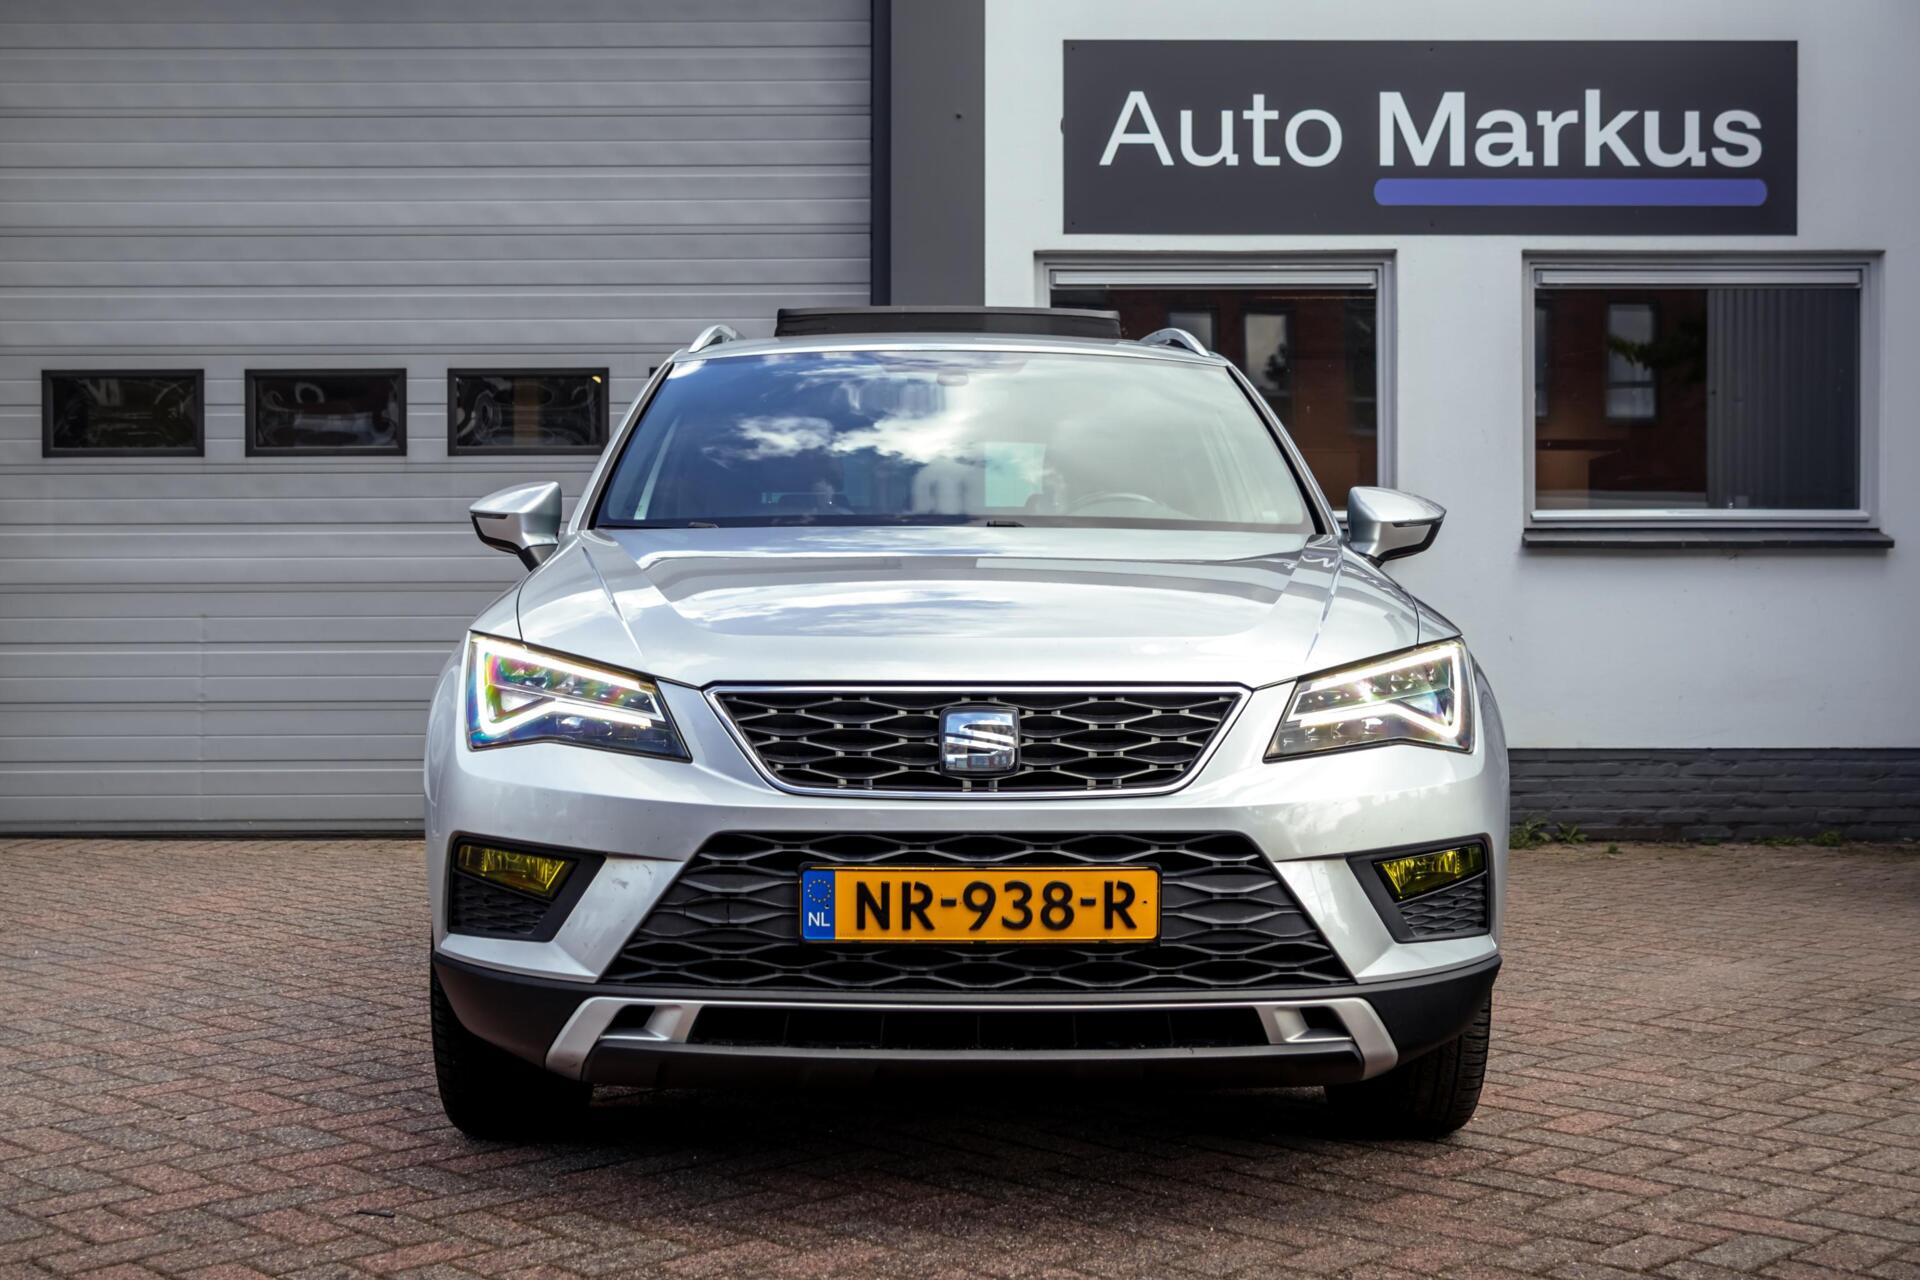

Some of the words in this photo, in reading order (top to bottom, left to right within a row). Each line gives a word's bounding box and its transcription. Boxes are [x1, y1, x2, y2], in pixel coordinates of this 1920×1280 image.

[1099, 90, 1342, 167] Auto
[1379, 89, 1763, 168] Markus
[808, 911, 830, 927] NL
[855, 880, 1137, 931] NR-938-R
